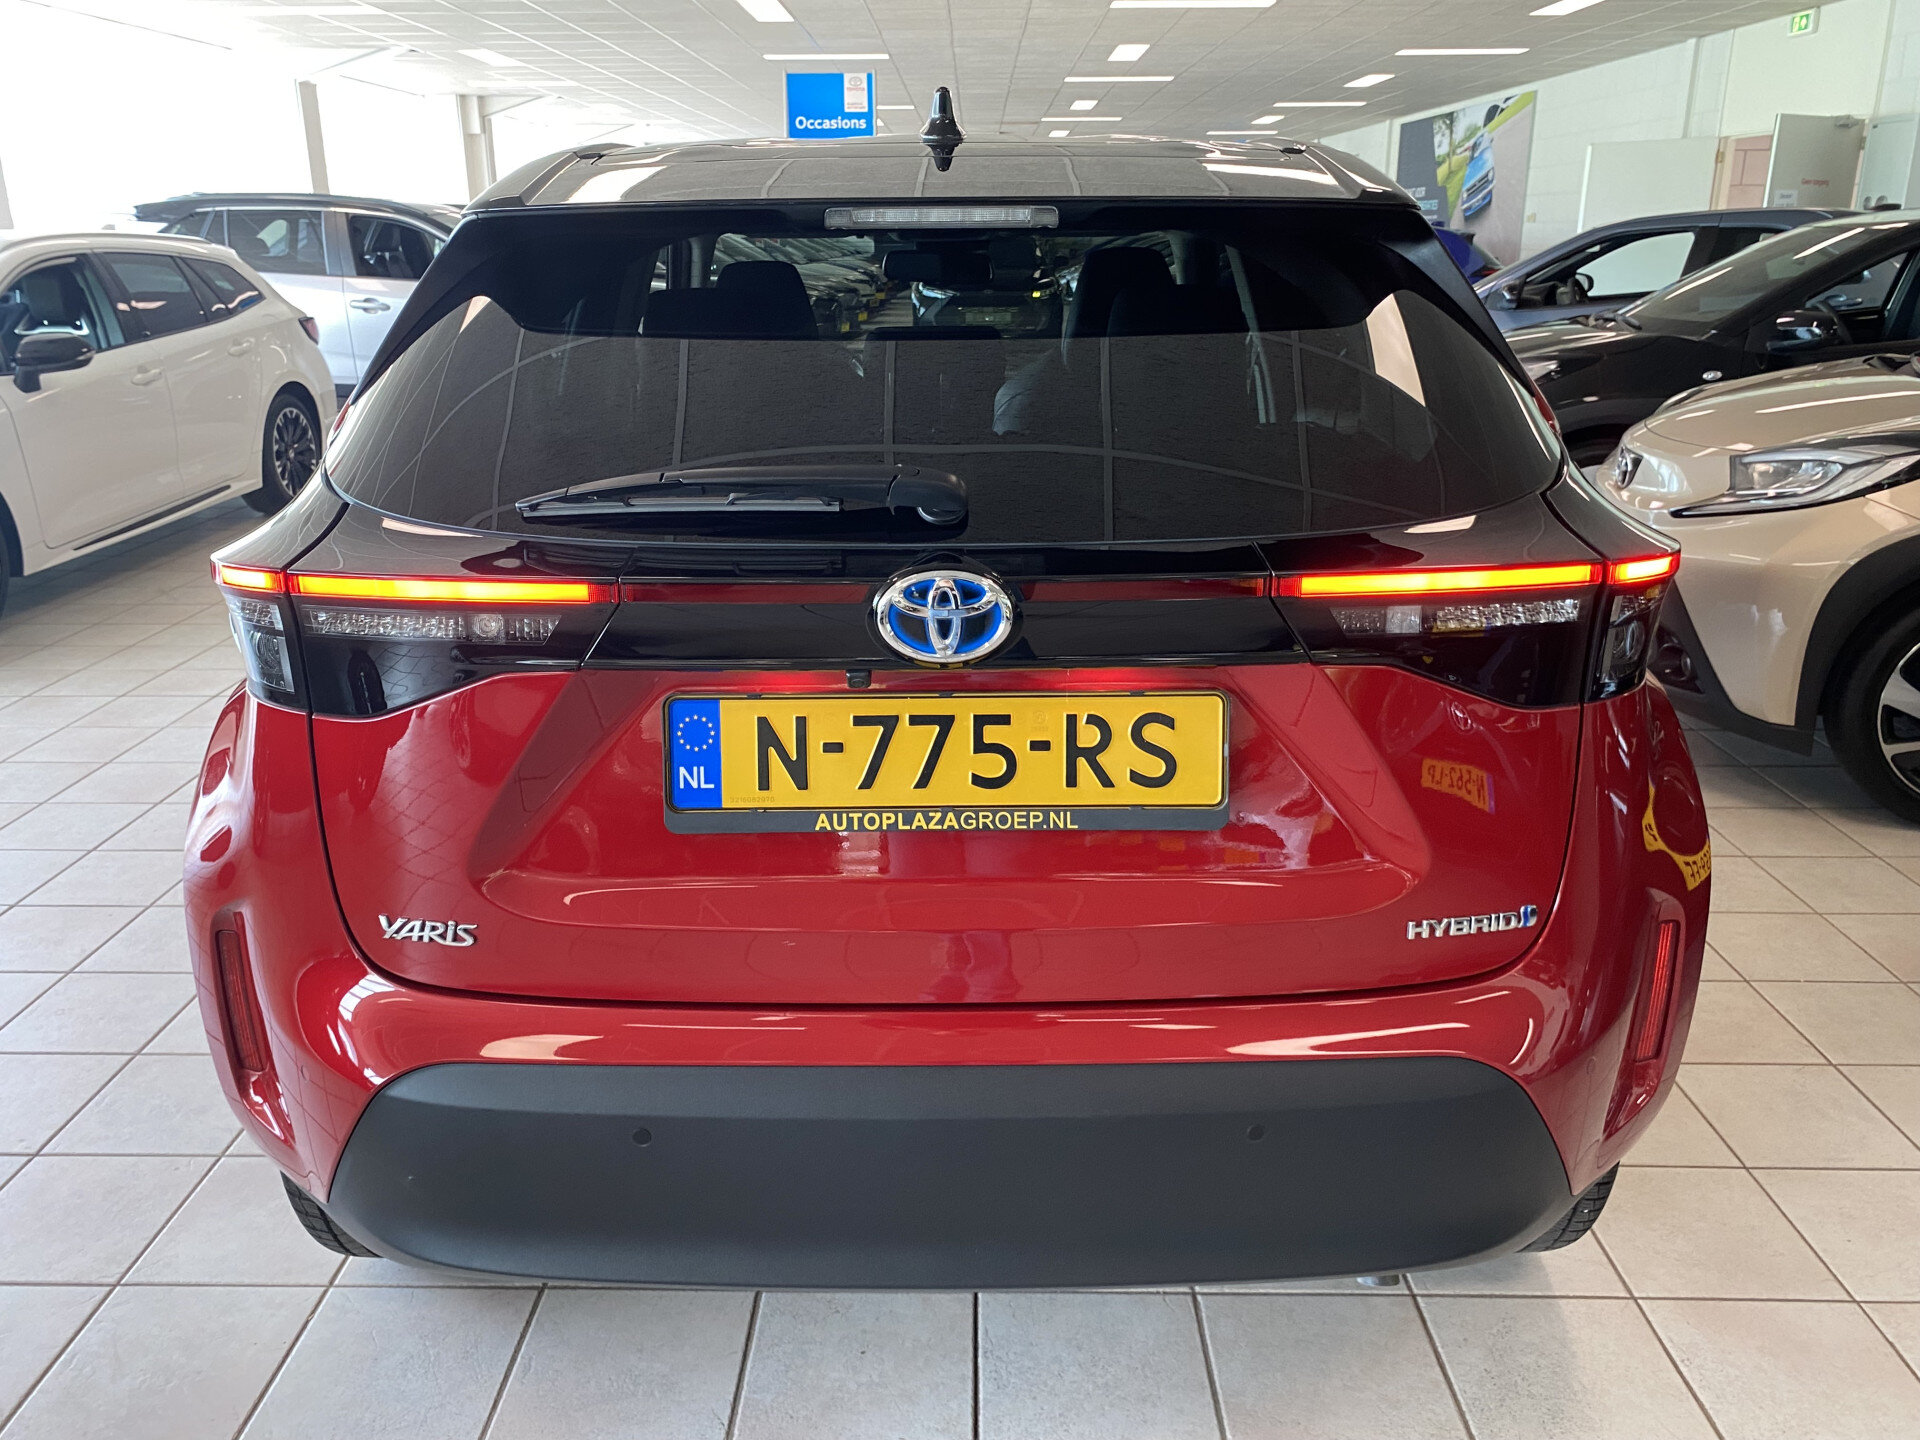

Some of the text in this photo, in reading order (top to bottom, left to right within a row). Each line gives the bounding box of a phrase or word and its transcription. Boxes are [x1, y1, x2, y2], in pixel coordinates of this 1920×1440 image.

[795, 115, 867, 129] Occasions
[756, 711, 1177, 791] N-775-RS
[679, 766, 715, 789] NL
[814, 811, 1079, 831] AUTOPLAZAGROEP.NL
[1406, 911, 1518, 940] HYBRID
